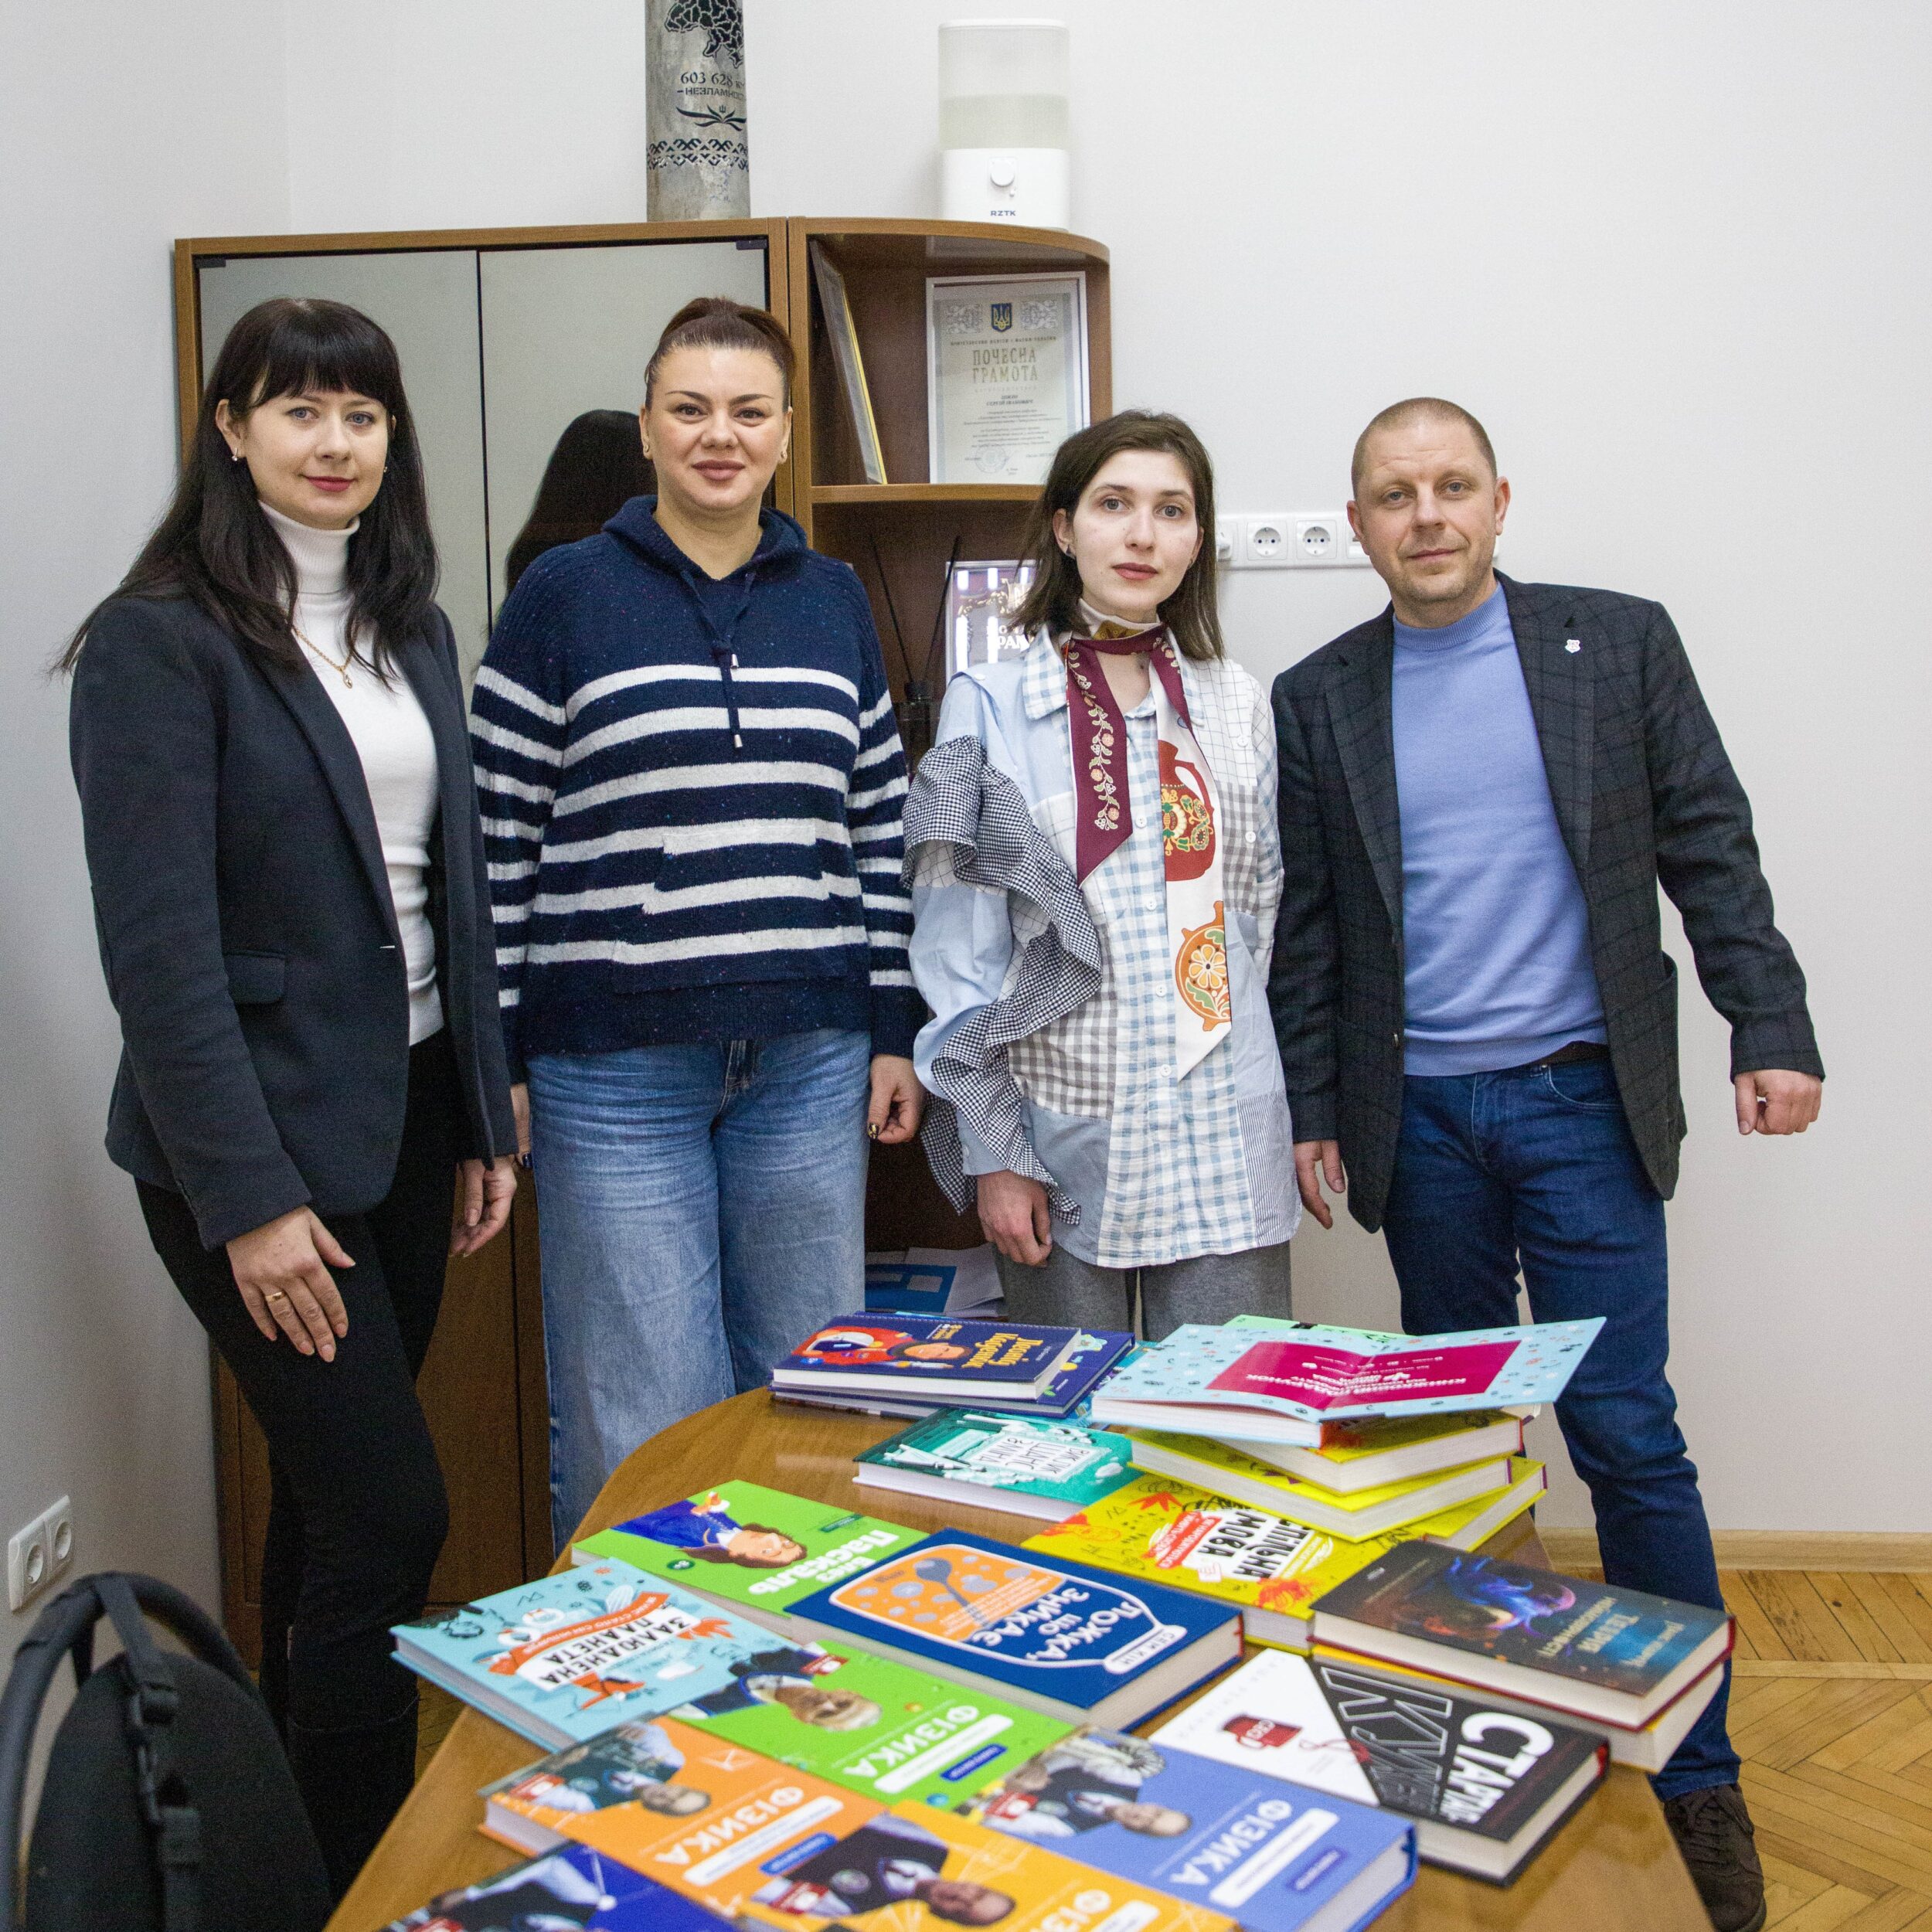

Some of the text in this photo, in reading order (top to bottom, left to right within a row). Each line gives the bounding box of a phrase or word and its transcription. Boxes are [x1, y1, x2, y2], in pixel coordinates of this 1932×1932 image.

[681, 71, 706, 84] 603
[711, 73, 733, 87] 628
[972, 348, 1037, 366] ПОЧЕСНА
[972, 365, 1038, 383] ГРАМОТА
[1005, 1442, 1067, 1470] ШАНС
[1196, 1512, 1267, 1558] МОВА
[748, 1529, 900, 1596] Паскаль
[816, 1556, 877, 1583] Блез
[972, 1587, 1090, 1648] ЗНИКАЄ
[1024, 1600, 1143, 1661] ЛОЖКА,
[1037, 1612, 1084, 1638] ЩО
[538, 1616, 690, 1685] ЗАЛЮДНЕНА
[543, 1618, 655, 1665] ПЛАНЕТА
[843, 1705, 980, 1778] ФІЗИКА
[654, 1786, 805, 1865] ФІЗИКА
[1168, 1799, 1293, 1886] ФІЗИКА
